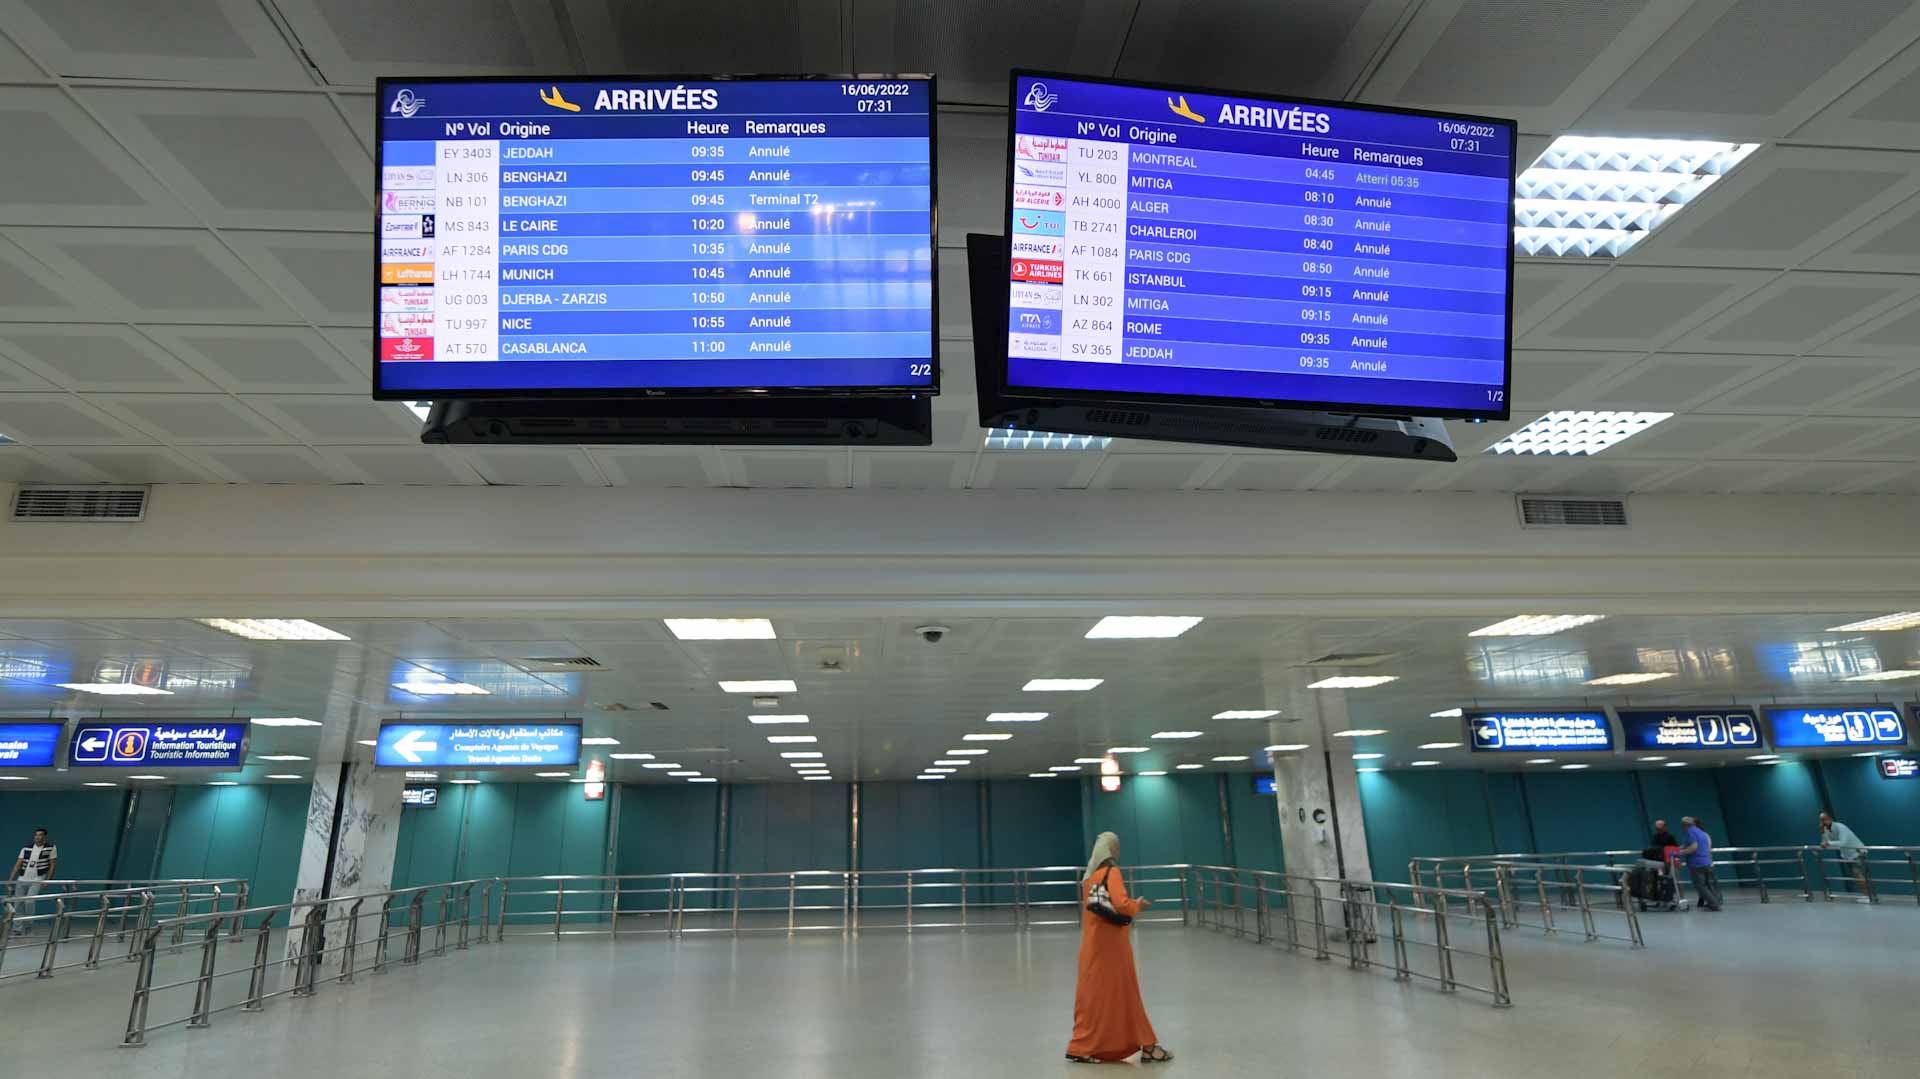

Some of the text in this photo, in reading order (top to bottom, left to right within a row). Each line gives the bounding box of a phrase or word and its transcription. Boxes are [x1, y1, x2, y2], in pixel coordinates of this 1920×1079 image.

[842, 85, 909, 96] 16/06/2022
[594, 86, 718, 111] ARRIVÉES
[858, 100, 892, 113] 07:31
[1218, 104, 1330, 133] ARRIVÉES
[468, 123, 490, 136] Vol
[500, 123, 550, 138] Origine
[687, 122, 729, 134] Heure
[746, 121, 825, 136] Remarques
[1438, 122, 1494, 137] 16/06/2022
[444, 145, 790, 158] EY 3403 JEDDAH 09:35 Annulé
[1100, 124, 1120, 138] Vol
[1130, 127, 1177, 144] Origine
[1302, 144, 1339, 158] Heure
[1354, 148, 1423, 167] Remarques
[1451, 139, 1480, 151] 07:31
[1079, 148, 1419, 187] TU 203 MONTREAL 04:45 Atterri 05:35
[447, 170, 790, 183] LN 306 BENGHAZI 09:45 Annulé
[1078, 172, 1093, 183] YL
[1096, 173, 1116, 184] 800
[1132, 177, 1173, 190] MITIGA
[1305, 191, 1334, 203] 08:10
[1355, 196, 1392, 209] Annulé
[446, 194, 818, 207] NB 101 BENGHAZI 09:45 Terminal T2
[1072, 197, 1390, 232] AH 4000 ALGER 08:30 Annulé
[445, 218, 790, 231] MS 843 LE CAIRE 10:20 Annulé
[1073, 221, 1390, 255] TB 2741 CHARLEROI 08:40 Annulé
[442, 242, 790, 256] AF 1284 PARIS CDG 10:35 Annulé
[1072, 245, 1389, 279] AF 1084 PARIS CDG 08:50 Annulé
[442, 267, 790, 280] LH 1744 MUNICH 10:45 Annulé
[1029, 270, 1062, 278] AIRLINES
[1075, 270, 1389, 302] TK 661 ISTANBUL 09:15 Annulé
[445, 295, 462, 305] UG
[466, 295, 488, 305] 003
[503, 294, 551, 305] DJERBA
[562, 294, 607, 304] ZARZIS
[692, 292, 724, 303] 10:50
[750, 291, 791, 302] Annulé
[1073, 295, 1089, 305] LN
[1092, 296, 1113, 307] 302
[1128, 298, 1169, 311] MITIGA
[1301, 309, 1331, 321] 09:15
[1352, 313, 1388, 325] Annulé
[446, 316, 791, 329] TU 997 NICE 10:55 Annulé
[1073, 320, 1387, 349] AZ 864 ROME 09:35 Annulé
[446, 341, 791, 354] AT 570 CASABLANCA 11:00 Annulé
[1072, 344, 1387, 372] SV 365 JEDDAH 09:35 Annulé
[911, 365, 931, 375] 2/2
[1488, 390, 1503, 402] 1/2
[152, 741, 236, 750] Information Touristique
